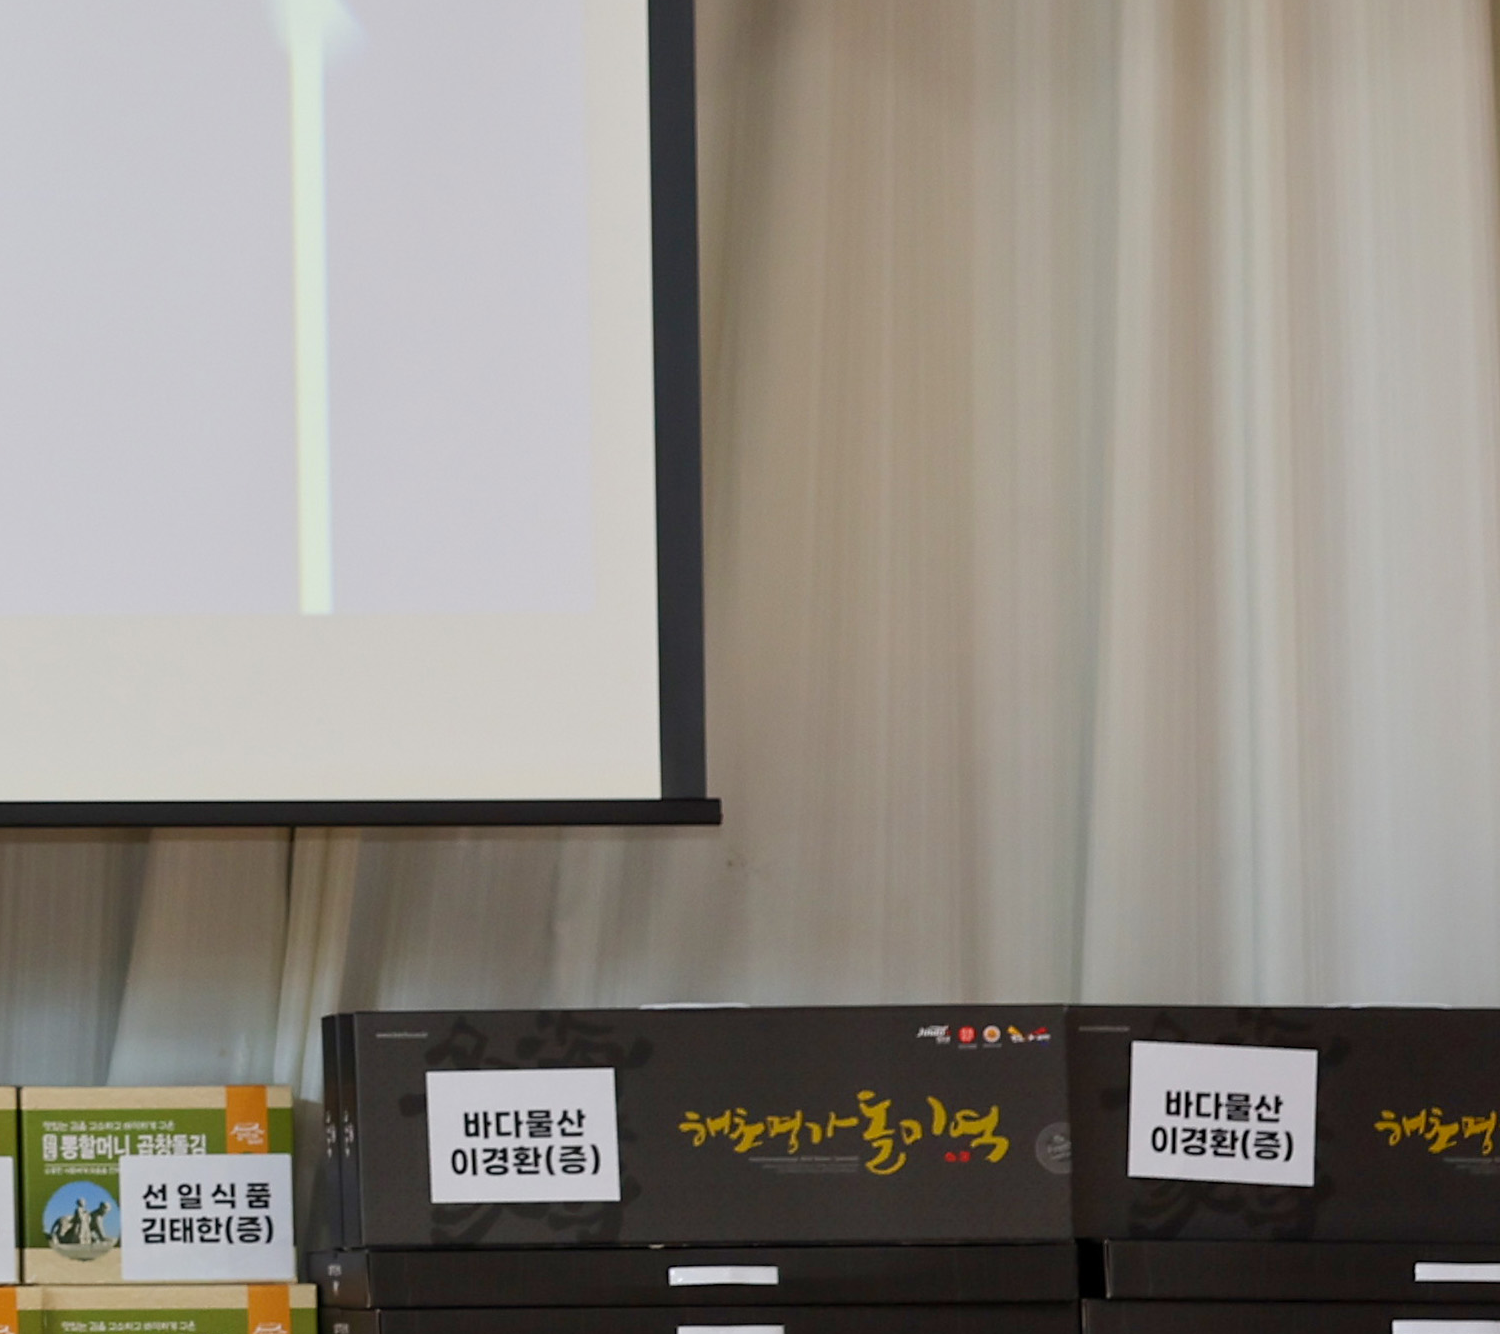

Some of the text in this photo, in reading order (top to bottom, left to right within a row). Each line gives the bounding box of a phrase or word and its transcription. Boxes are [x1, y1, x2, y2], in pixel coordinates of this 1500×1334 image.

[1166, 1091, 1283, 1123] 바다물산
[464, 1109, 585, 1139] 바다물산
[1375, 1106, 1500, 1154] 해초명
[1152, 1127, 1293, 1161] 이경환(증)
[452, 1145, 600, 1175] 이경환(증)
[143, 1216, 273, 1244] 김태한(증)
